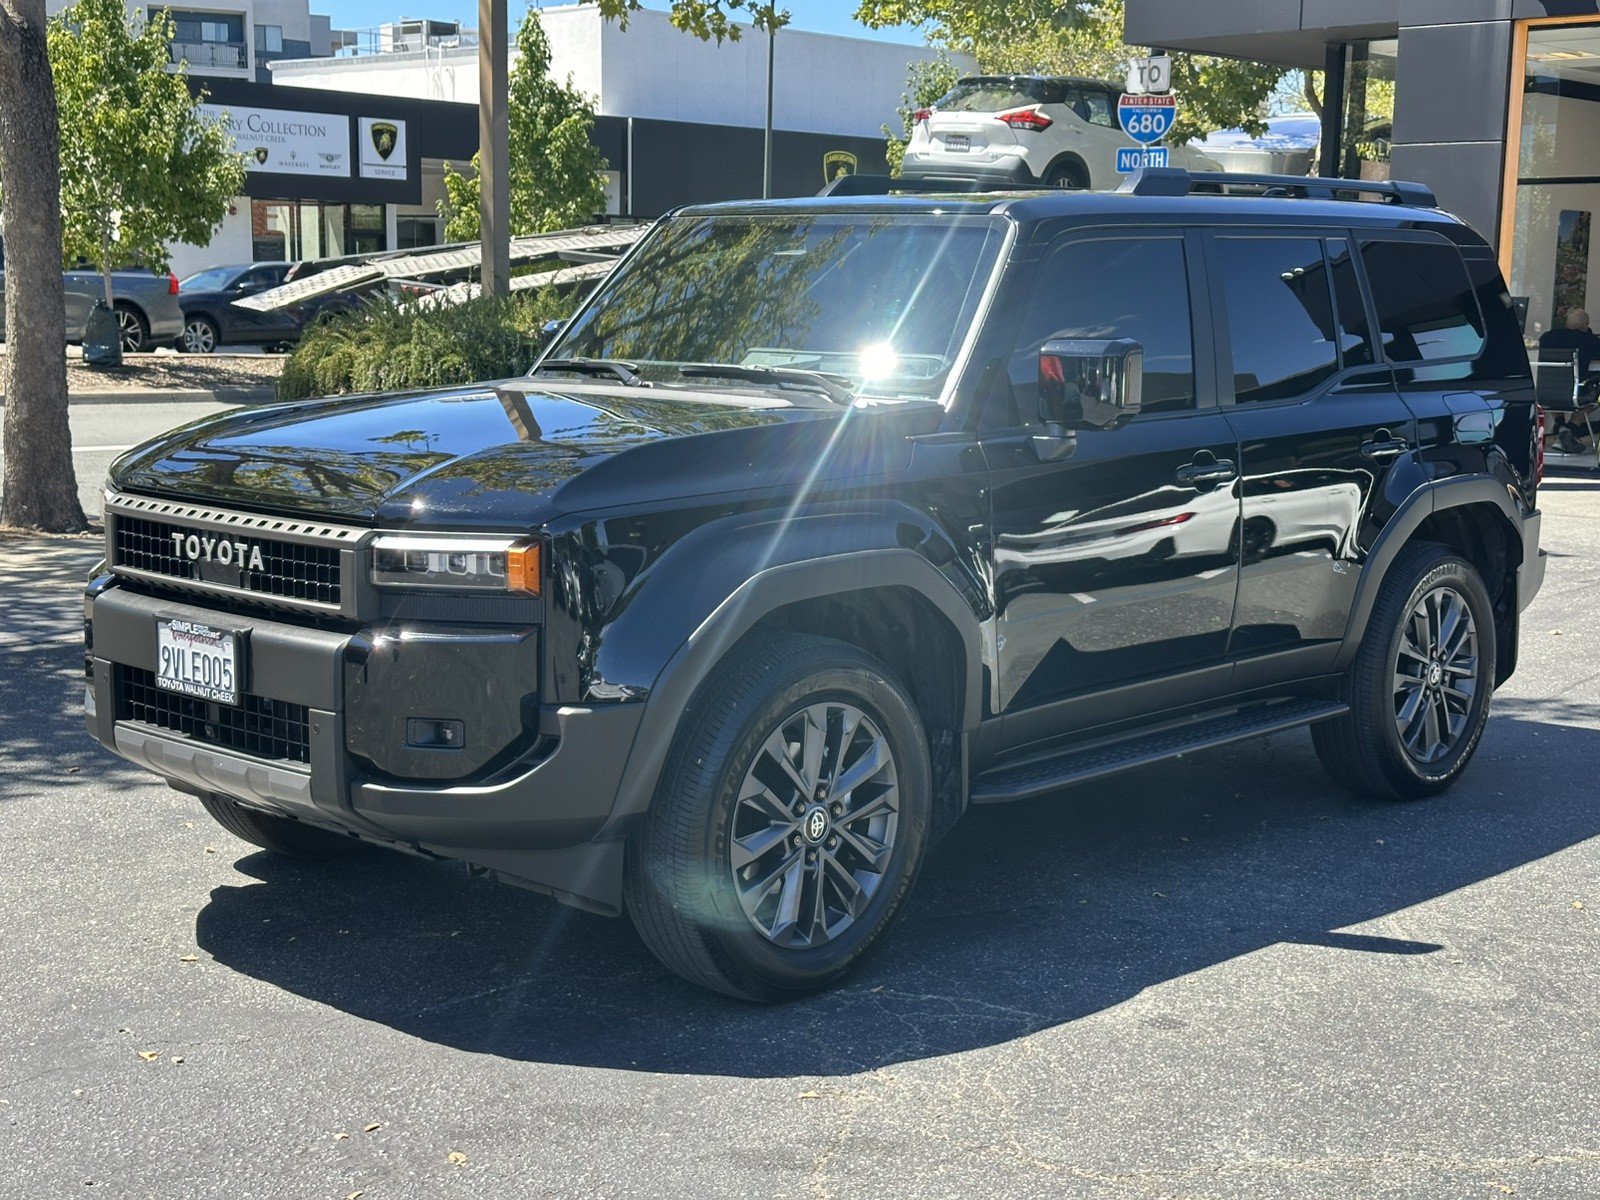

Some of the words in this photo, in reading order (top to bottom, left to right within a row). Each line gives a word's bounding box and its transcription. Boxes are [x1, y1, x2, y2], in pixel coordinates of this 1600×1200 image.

[1137, 64, 1160, 84] TO
[1124, 97, 1171, 106] INTERSTATE
[247, 113, 327, 137] COLLECTION
[1128, 114, 1165, 133] 680
[236, 131, 264, 142] WALNUT
[265, 134, 286, 144] CREEK
[279, 160, 309, 169] MASERATI
[1121, 151, 1164, 168] NORTH
[374, 168, 396, 176] SERVICE
[171, 532, 265, 571] TOYOTA
[161, 645, 232, 691] 9VLE005
[157, 676, 184, 692] TOYOTA
[184, 682, 211, 698] WALNUT
